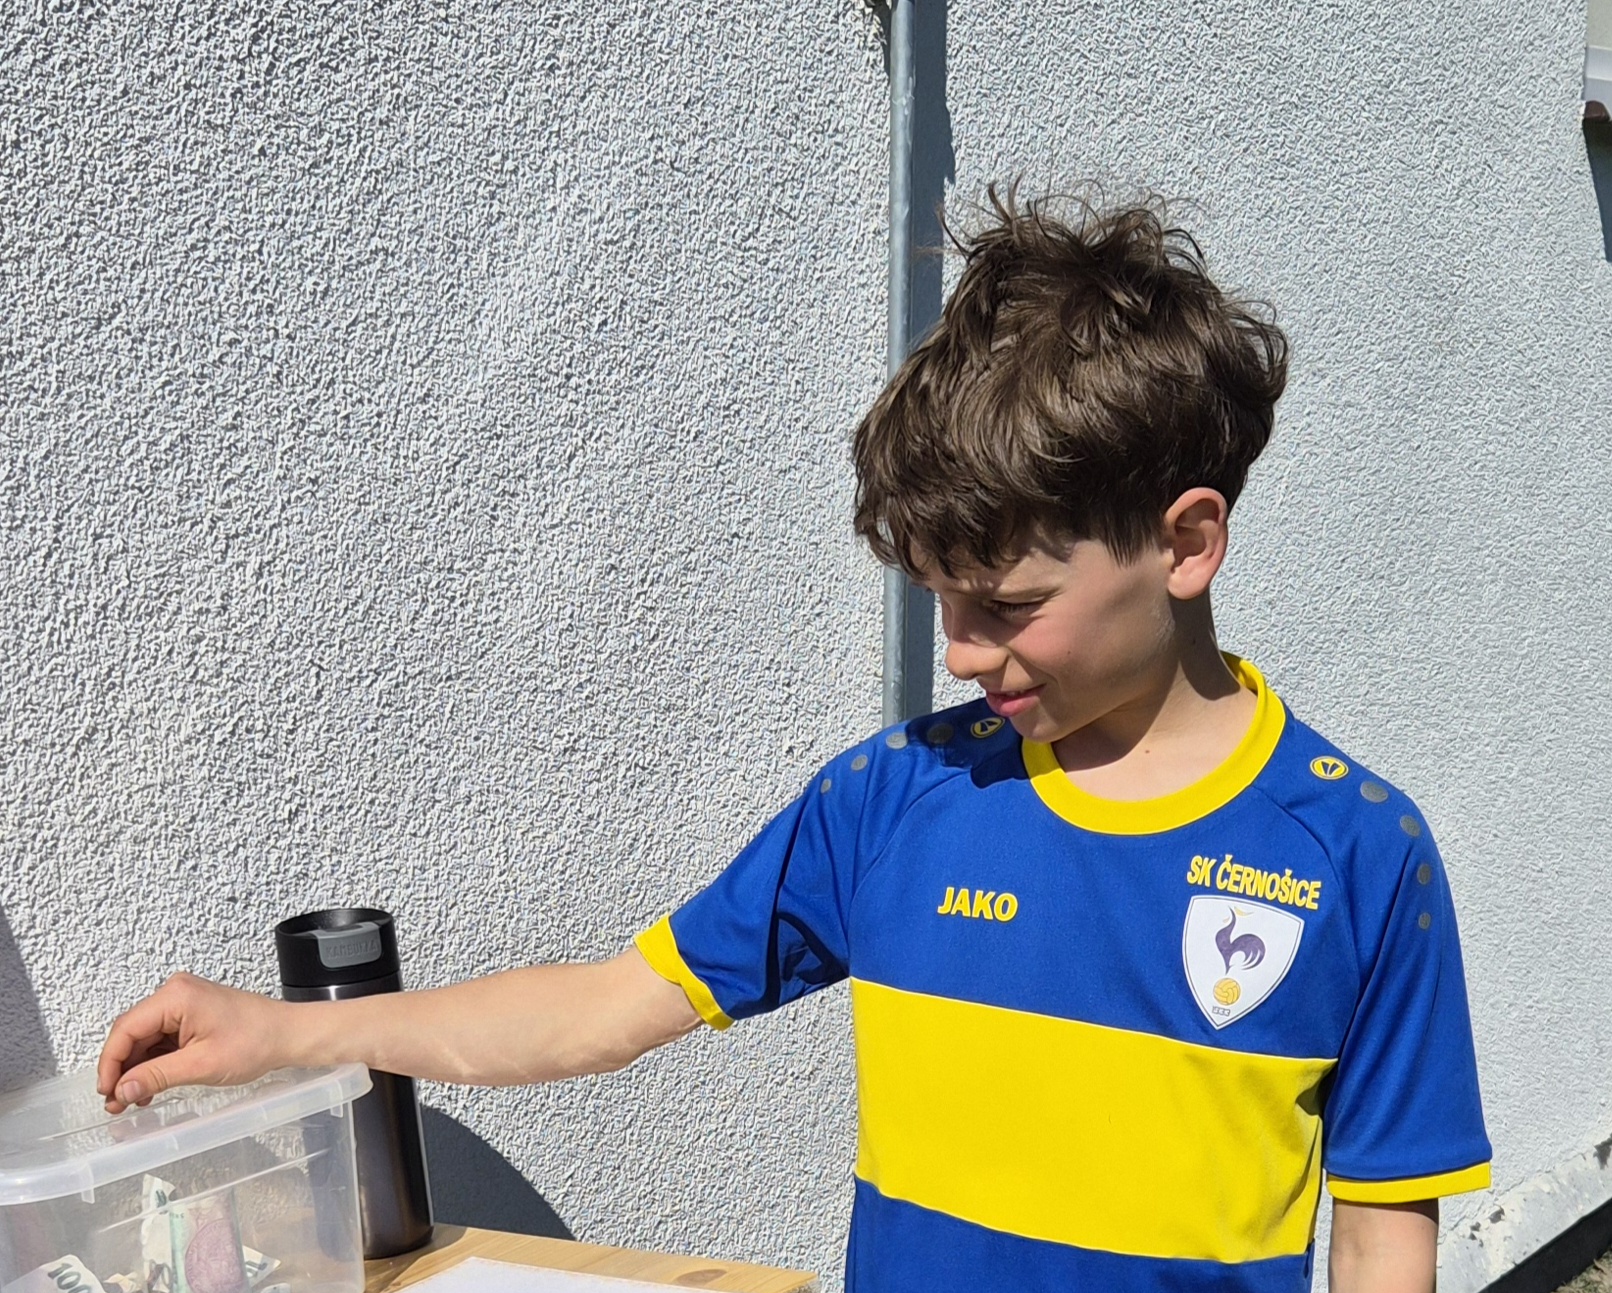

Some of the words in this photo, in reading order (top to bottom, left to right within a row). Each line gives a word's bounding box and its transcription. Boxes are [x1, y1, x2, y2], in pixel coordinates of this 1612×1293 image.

[937, 886, 1019, 922] JAKO
[1187, 855, 1217, 887] SK
[1216, 854, 1321, 910] ČERNOŠICE
